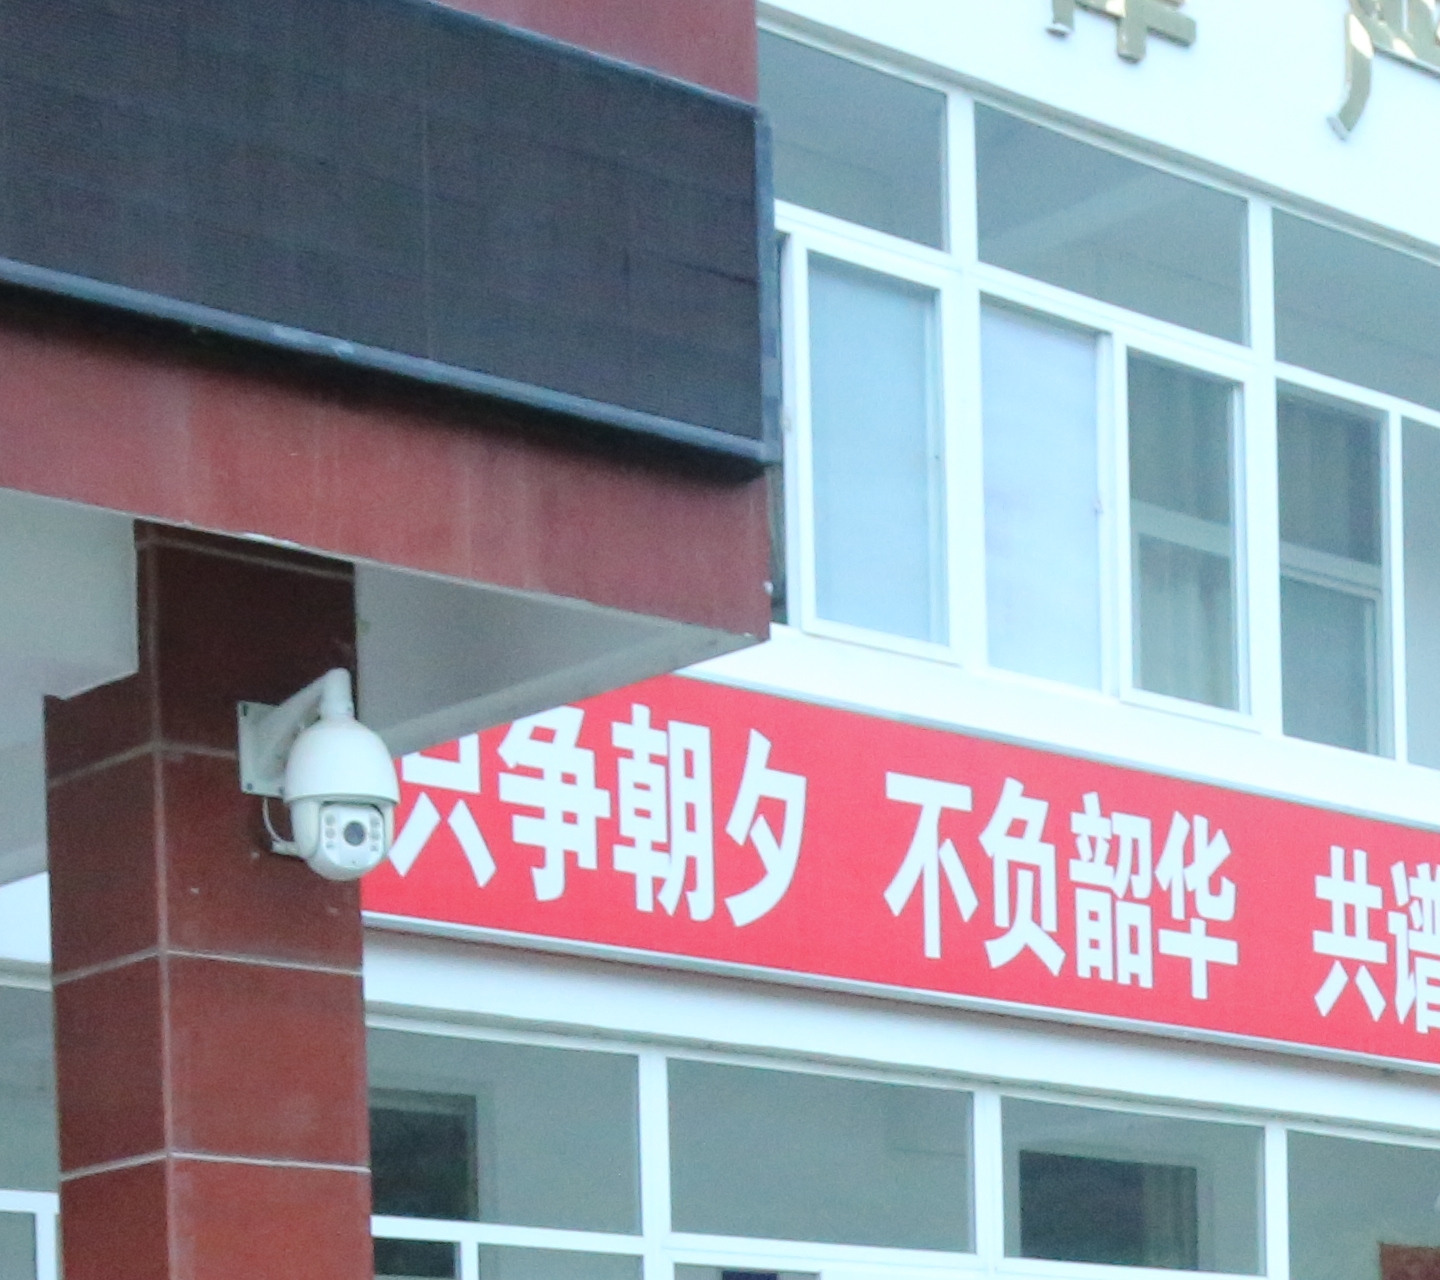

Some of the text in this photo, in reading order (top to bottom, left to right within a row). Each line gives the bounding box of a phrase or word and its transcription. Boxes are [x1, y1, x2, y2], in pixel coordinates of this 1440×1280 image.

[390, 703, 807, 928] 只争朝夕
[883, 771, 1239, 999] 不负韶华
